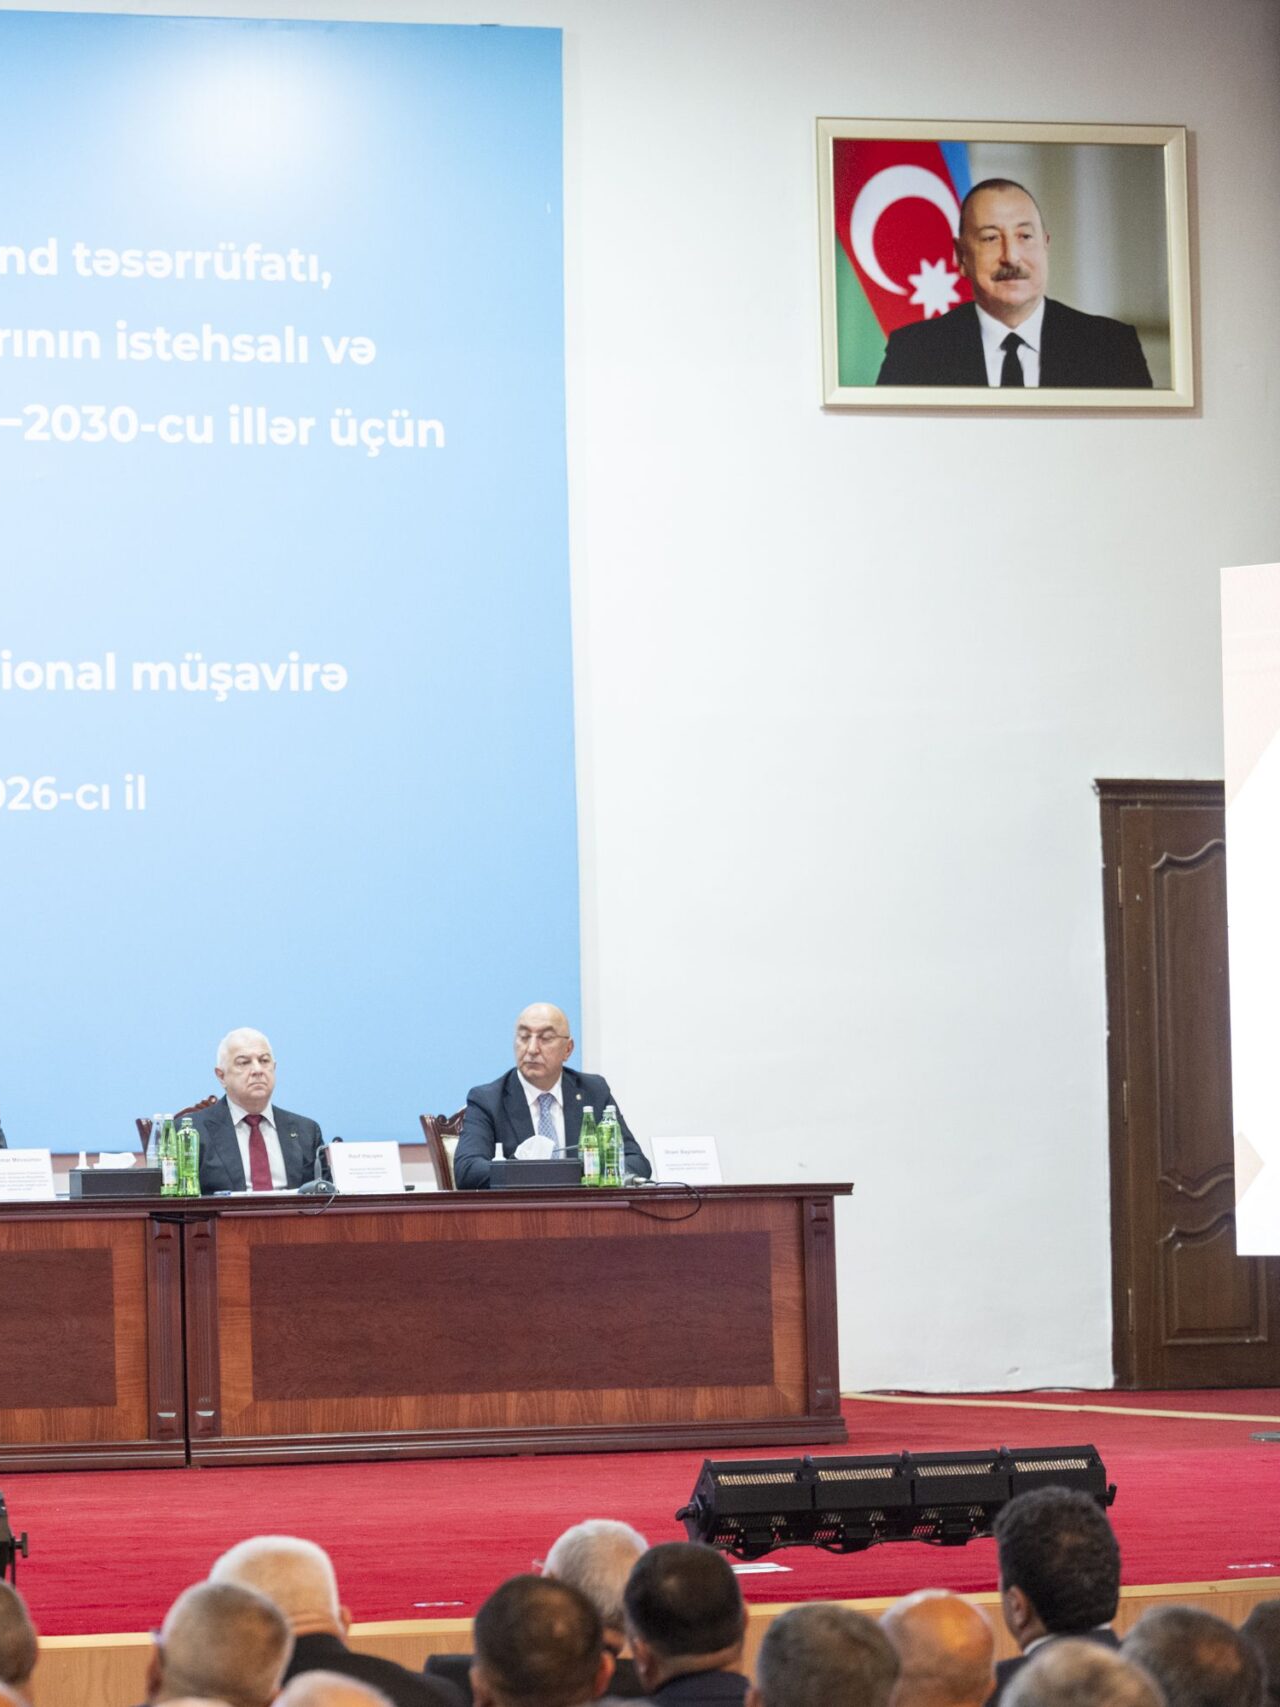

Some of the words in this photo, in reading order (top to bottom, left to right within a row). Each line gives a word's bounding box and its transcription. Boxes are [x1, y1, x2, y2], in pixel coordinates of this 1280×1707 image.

[72, 242, 331, 289] təsərrüfatı,
[116, 320, 308, 363] istehsalı
[322, 336, 376, 365] və
[229, 404, 316, 446] illər
[330, 408, 445, 457] üçün
[133, 651, 348, 702] müşavirə
[125, 773, 146, 810] il
